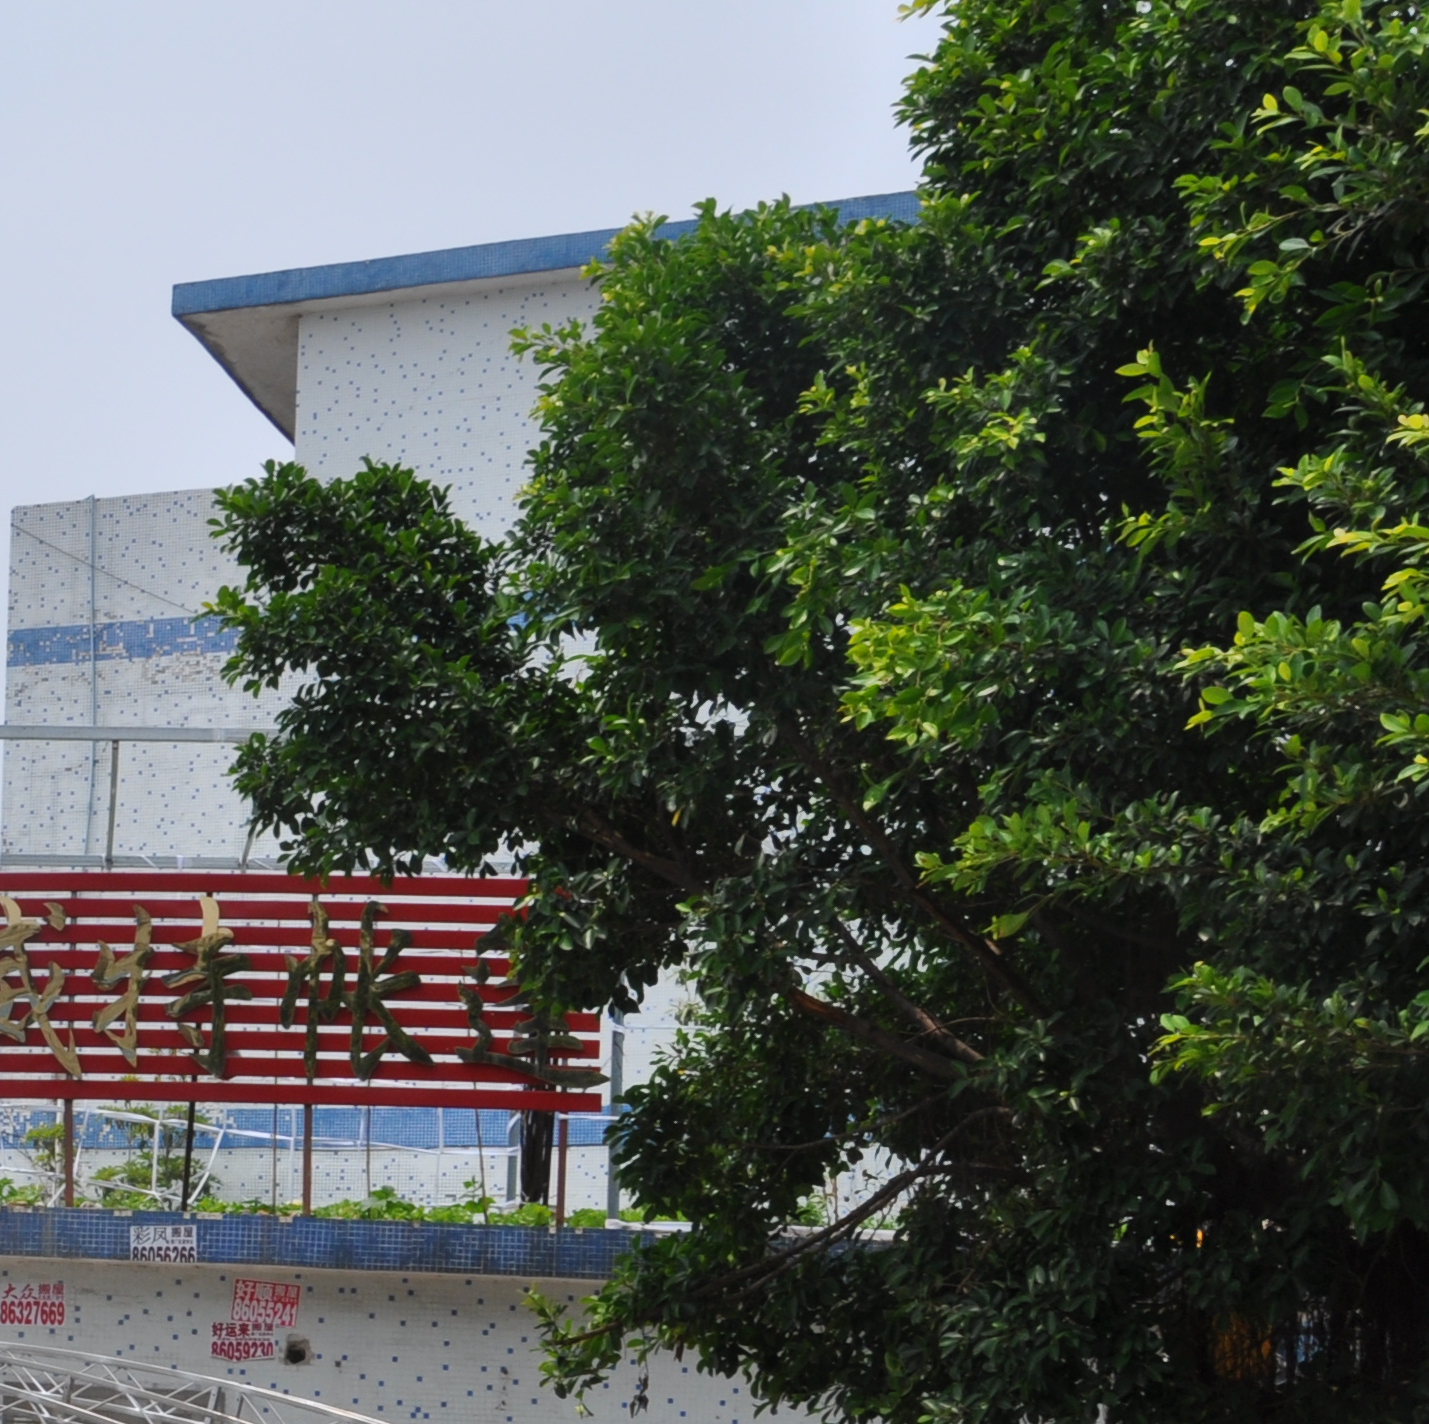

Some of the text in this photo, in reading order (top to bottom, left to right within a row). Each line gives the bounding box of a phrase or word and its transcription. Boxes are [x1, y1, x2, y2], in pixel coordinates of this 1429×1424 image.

[132, 1225, 171, 1245] 彩凤
[2, 1282, 38, 1300] 大众
[0, 1301, 65, 1325] 86327669
[233, 1300, 298, 1326] 86055241
[211, 1322, 250, 1337] 好运来
